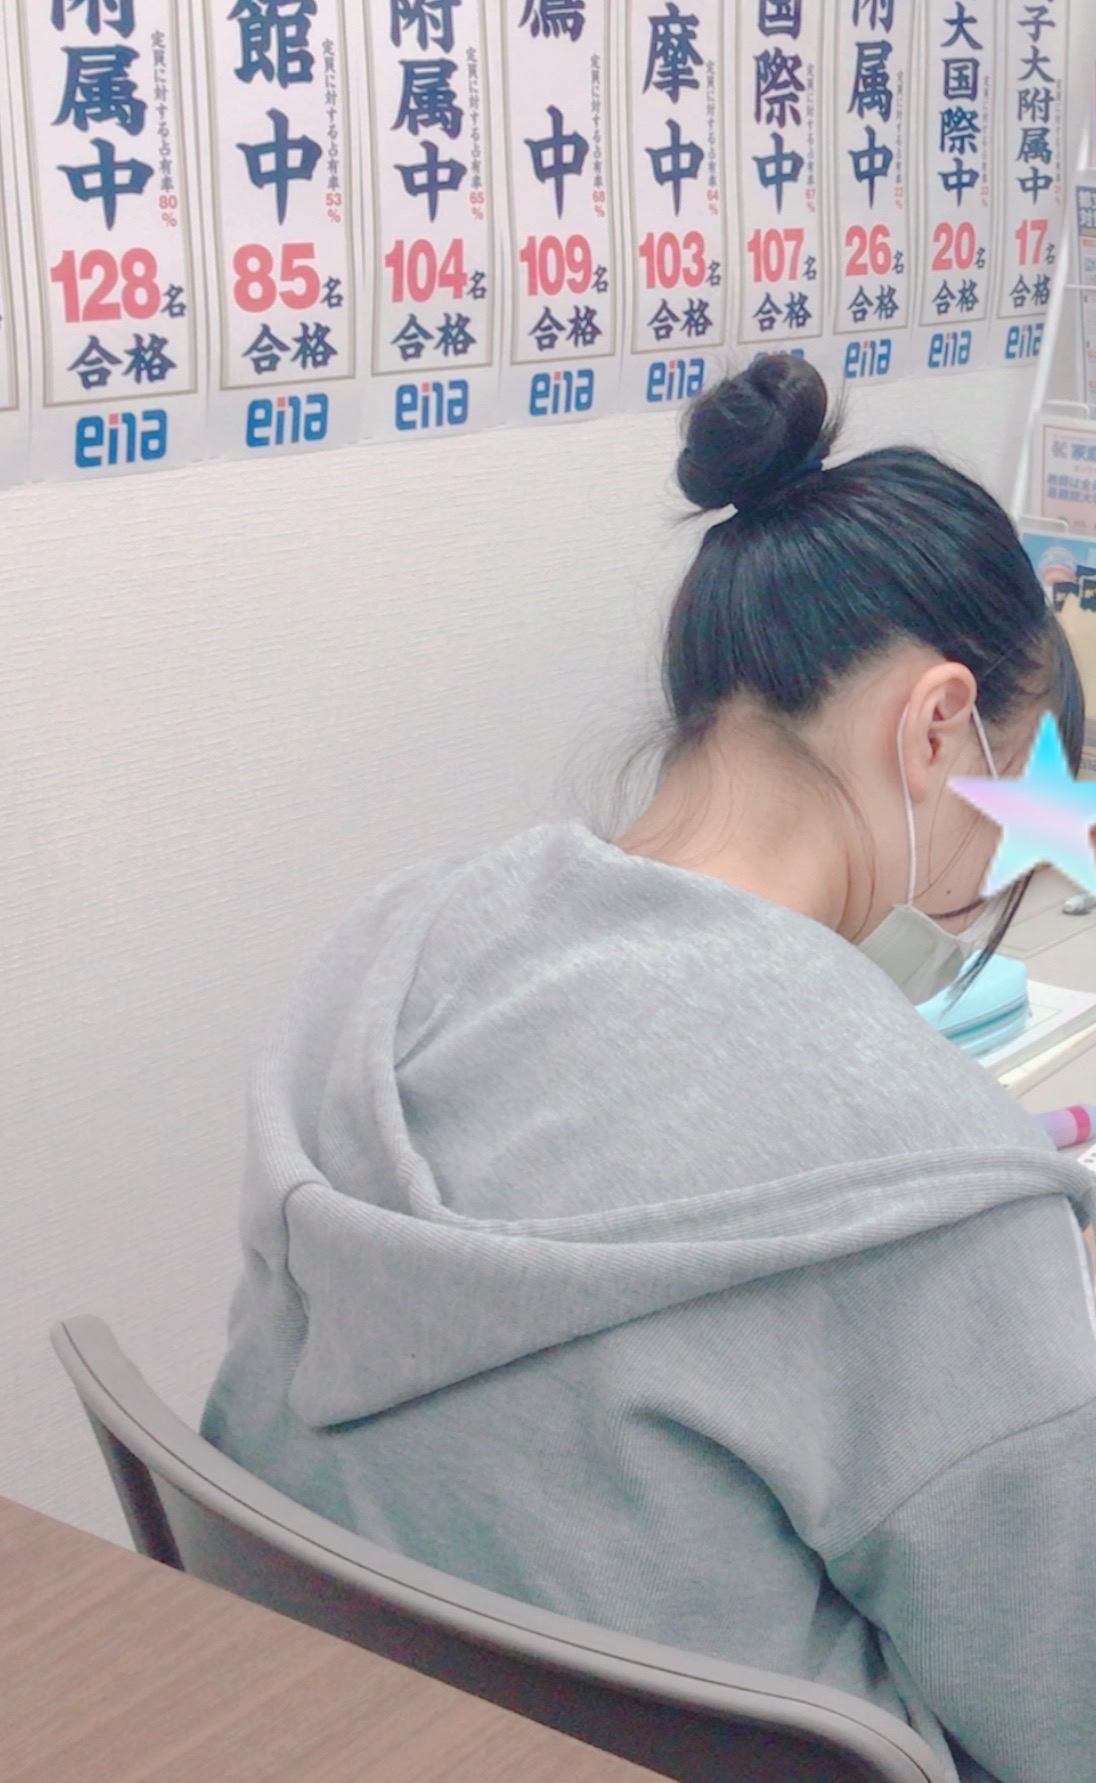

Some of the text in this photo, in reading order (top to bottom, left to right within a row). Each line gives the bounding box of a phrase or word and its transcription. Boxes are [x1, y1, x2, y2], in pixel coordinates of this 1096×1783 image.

[519, 234, 609, 296] 109名
[639, 230, 721, 289] 103名
[747, 227, 817, 284] 107名
[845, 224, 905, 277] 26名
[932, 221, 986, 271] 20名
[1015, 219, 1055, 266] 17名
[50, 247, 188, 323] 128名
[232, 242, 345, 313] 85名
[384, 238, 487, 303] 104名
[1009, 274, 1050, 309] 合格
[647, 298, 713, 342] 合格
[752, 291, 813, 332] 合格
[847, 285, 899, 324] 合格
[932, 279, 980, 315] 合格
[241, 322, 338, 375] 合格
[390, 312, 477, 362] 合格
[528, 305, 603, 352] 合格
[67, 332, 178, 390] 合格
